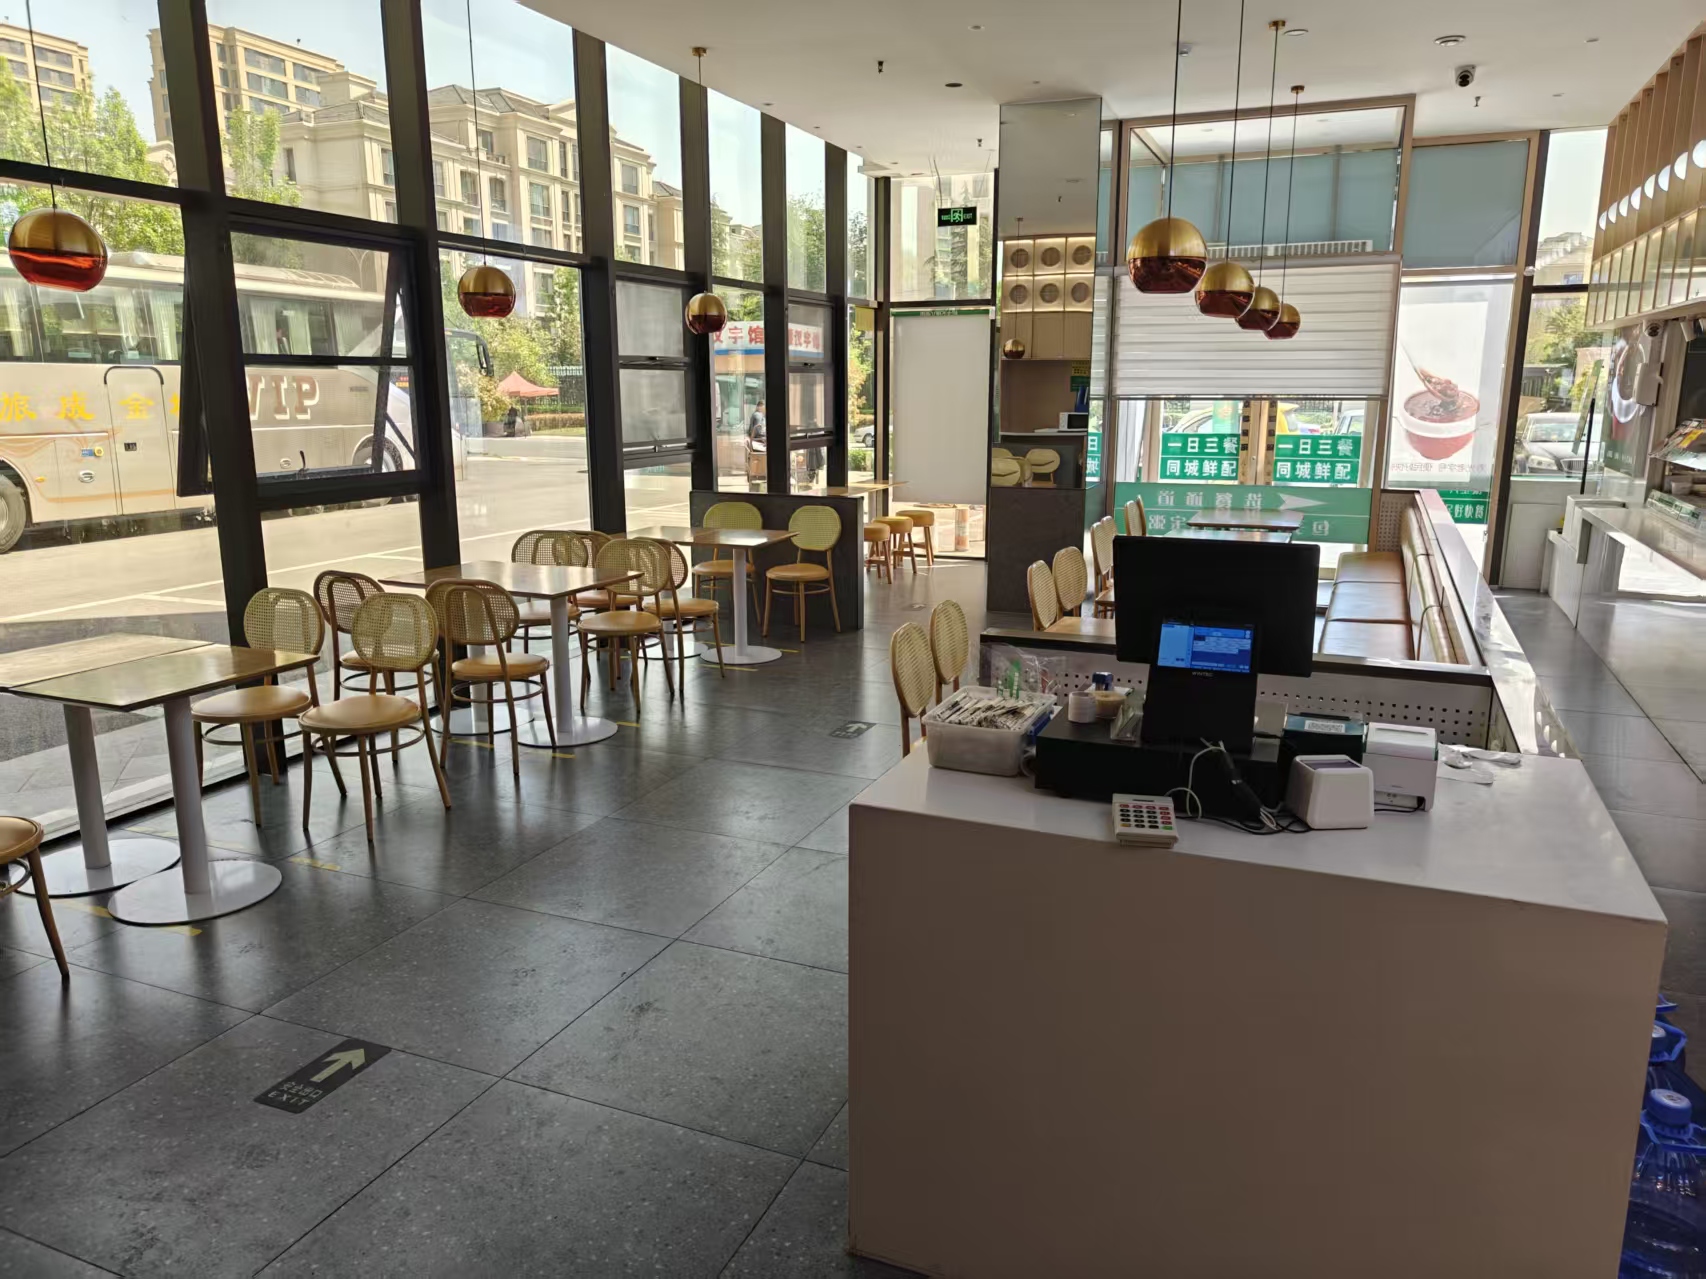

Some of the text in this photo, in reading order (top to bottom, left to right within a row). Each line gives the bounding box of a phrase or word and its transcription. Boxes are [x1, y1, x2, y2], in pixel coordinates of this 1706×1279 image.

[1168, 437, 1238, 454] 一日三餐
[1277, 438, 1353, 456] 一日三餐
[1166, 460, 1237, 477] 同城鲜配
[1276, 461, 1351, 480] 同城鲜配
[267, 1090, 310, 1106] EXIT
